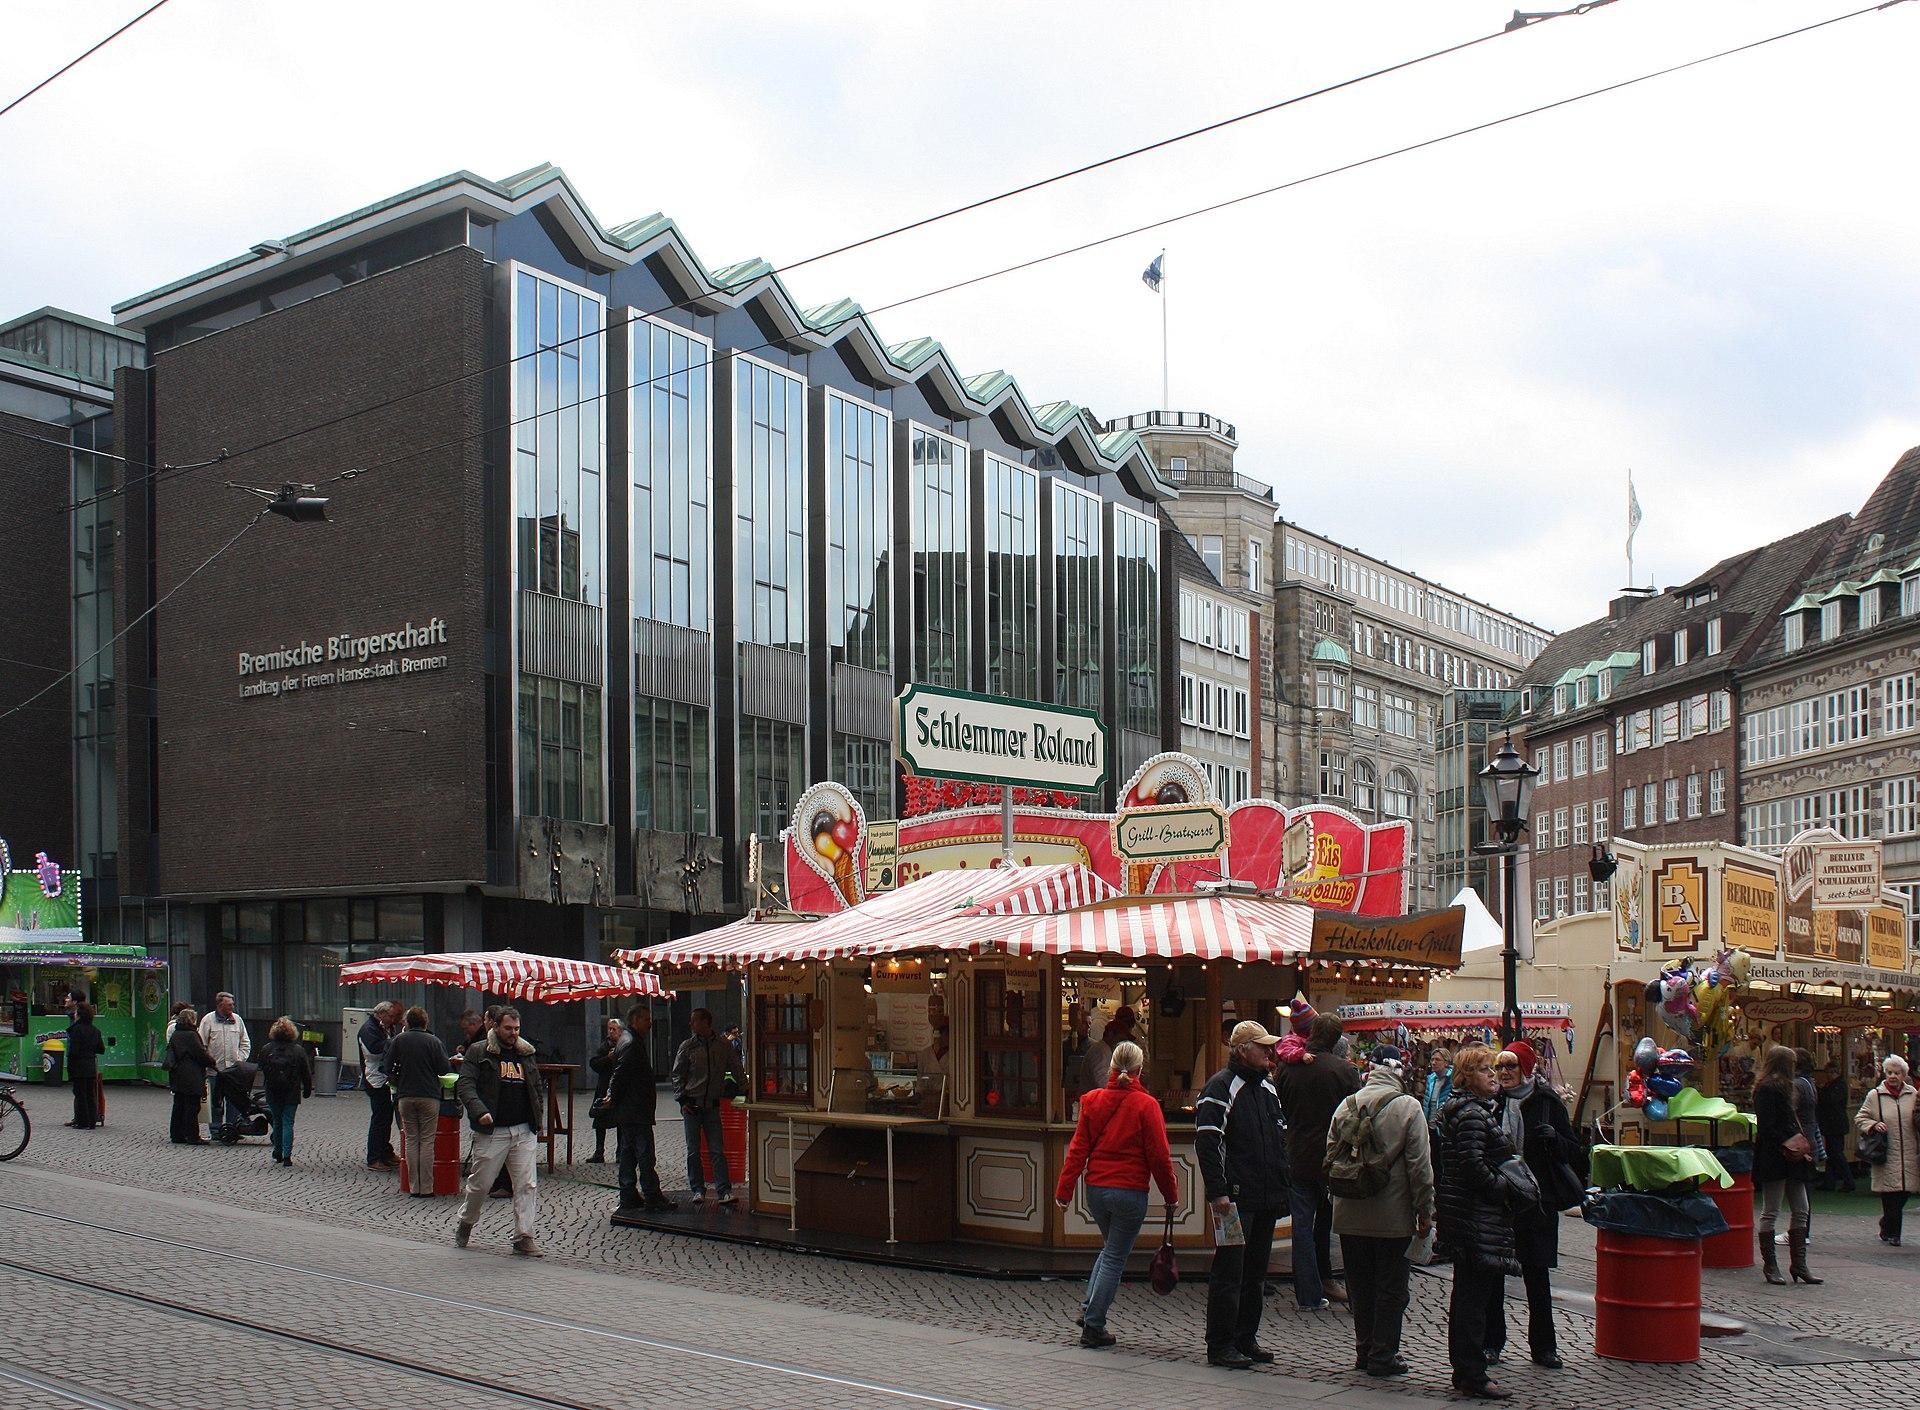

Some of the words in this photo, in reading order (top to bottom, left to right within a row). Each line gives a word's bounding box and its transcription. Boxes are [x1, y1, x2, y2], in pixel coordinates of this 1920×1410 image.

[238, 640, 323, 676] Bremische
[327, 616, 448, 662] Bürgerschaft
[239, 678, 279, 698] Landtag
[281, 674, 300, 692] der
[302, 671, 335, 688] Freien
[336, 658, 399, 683] Hansestadt
[401, 653, 448, 673] Bremen
[915, 705, 1028, 760] Schlemmer
[1032, 722, 1099, 769] Roland
[1126, 823, 1215, 849] Grill-Bratwurst
[1317, 837, 1340, 868] Eis
[1829, 852, 1866, 863] BERLINER
[1822, 864, 1873, 874] APFELTASCHEN
[1817, 876, 1877, 886] SCHMALZKUCHEN
[1662, 884, 1687, 907] B
[1726, 881, 1776, 912] BERLINER
[1827, 890, 1846, 900] stets
[1847, 884, 1872, 899] frisch
[1674, 903, 1699, 925] A
[1729, 913, 1772, 938] APFELTASCHEN
[1324, 926, 1458, 959] Holzkohlen-Grill
[757, 973, 792, 982] Krakauer
[875, 969, 922, 982] Currywurst
[1347, 1009, 1380, 1019] Ballons
[1403, 1008, 1487, 1017] Spielwaren
[1750, 1001, 1809, 1018] Apfeltaschen
[1821, 1010, 1873, 1023] Berliner
